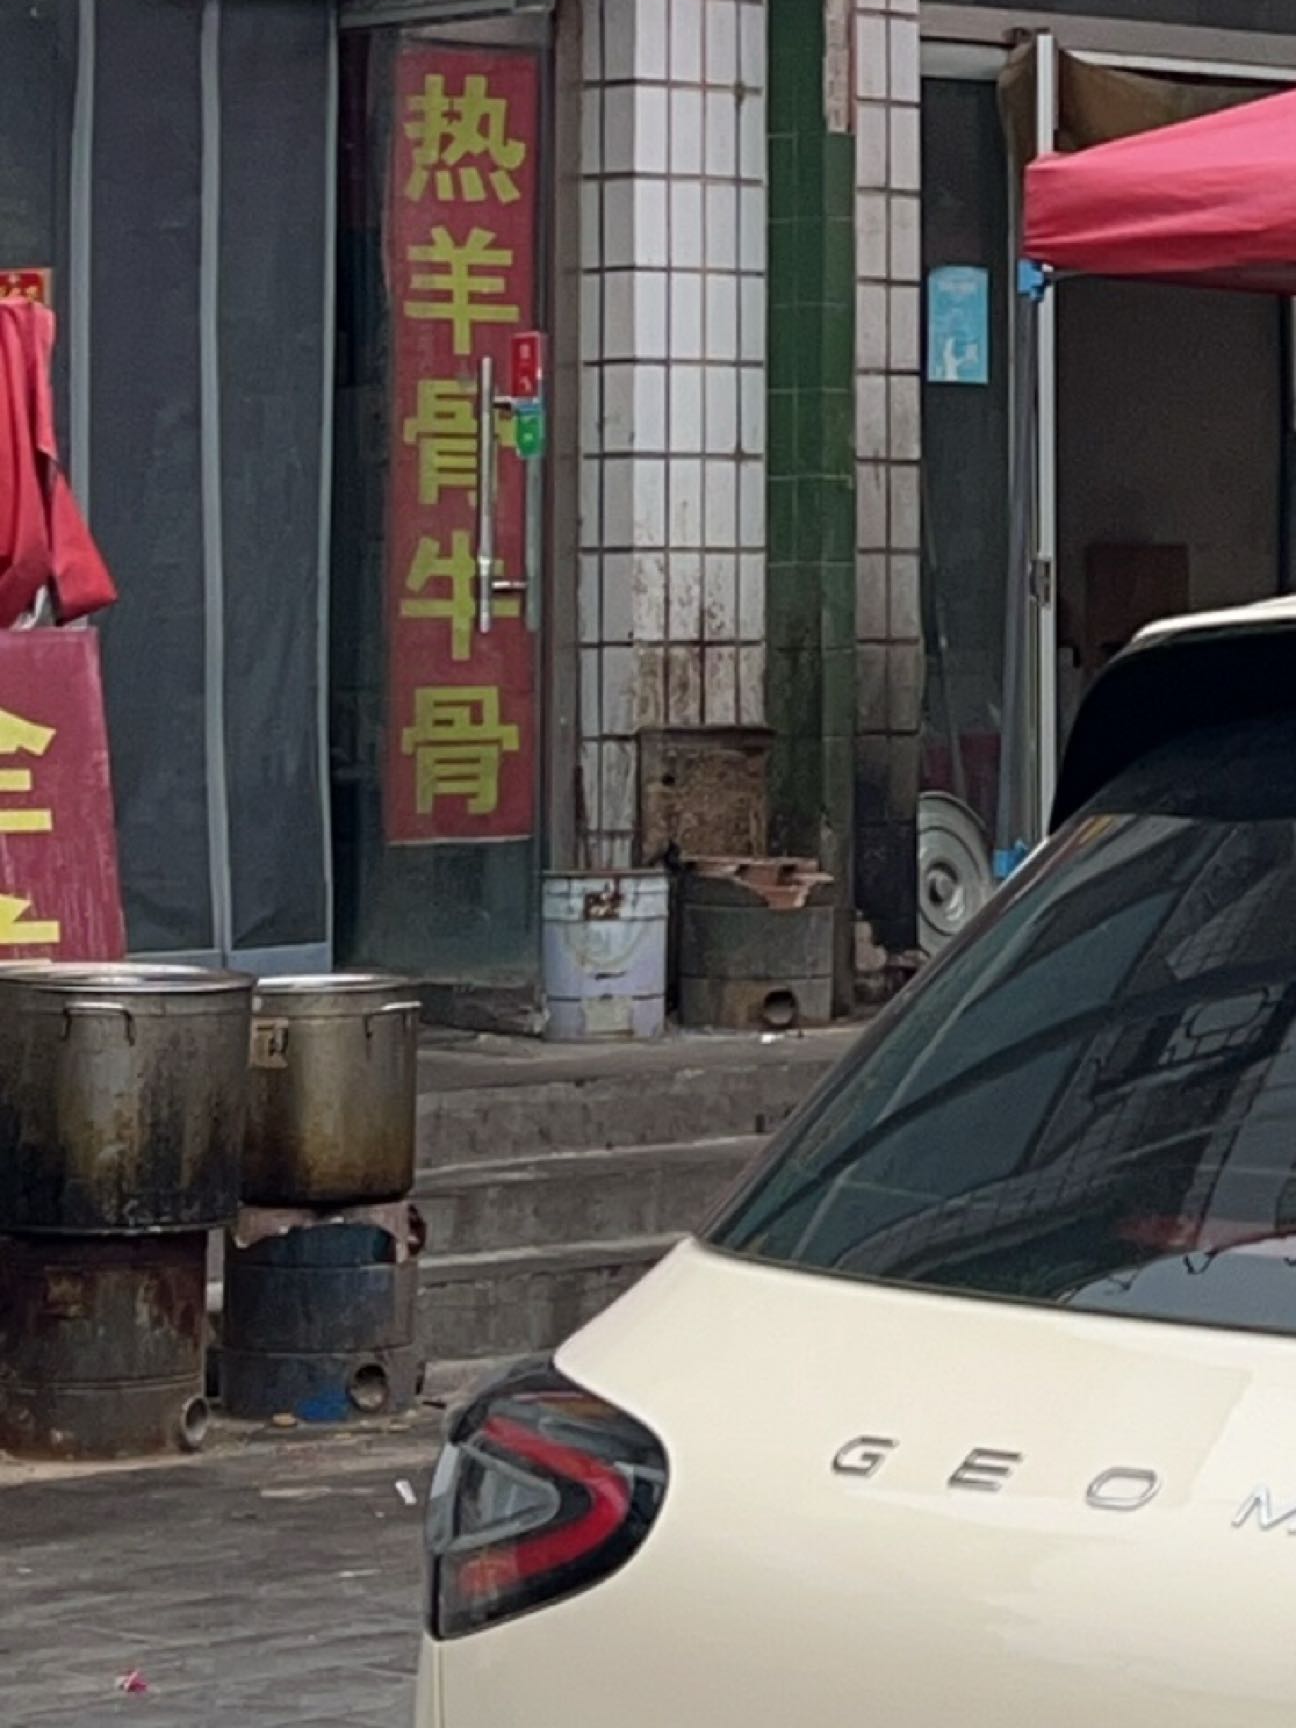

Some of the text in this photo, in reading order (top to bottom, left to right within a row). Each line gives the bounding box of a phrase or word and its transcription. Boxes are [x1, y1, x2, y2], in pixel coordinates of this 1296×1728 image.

[402, 73, 527, 816] 热羊骨牛骨
